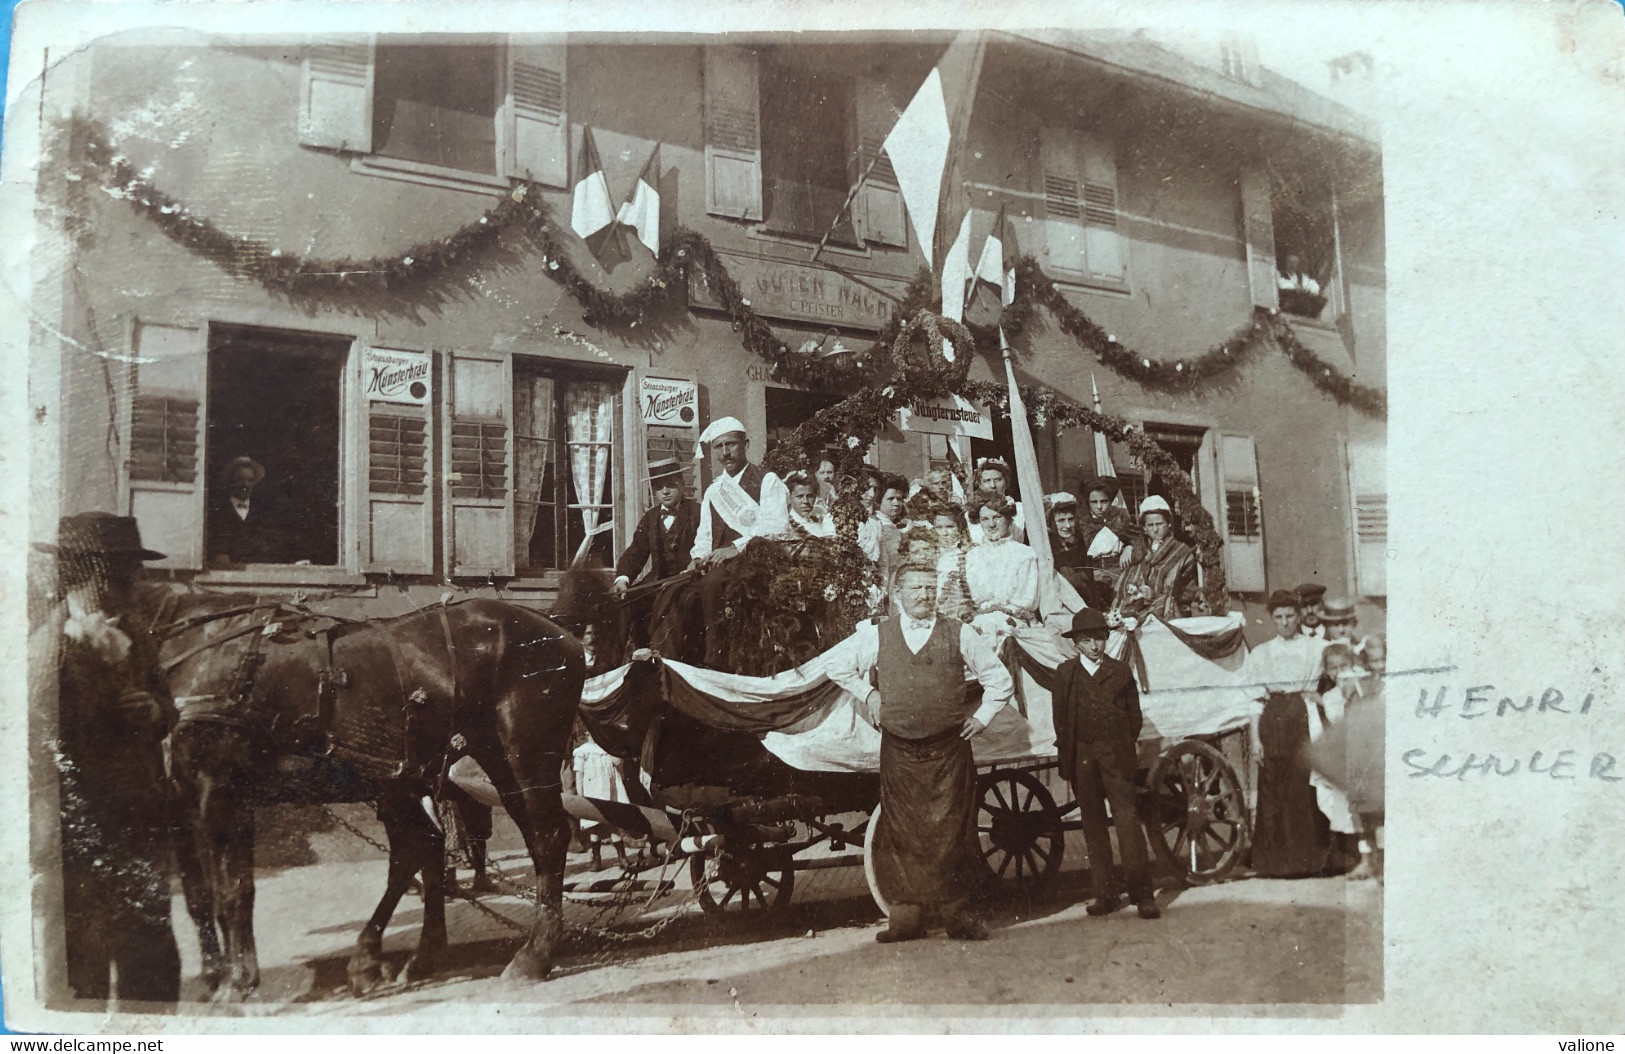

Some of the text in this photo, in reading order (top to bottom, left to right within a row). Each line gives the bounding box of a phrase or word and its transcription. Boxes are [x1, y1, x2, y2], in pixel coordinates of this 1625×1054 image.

[800, 299, 844, 318] PFISTER
[366, 351, 410, 366] Strassburger
[367, 360, 429, 395] Münsterbräu
[643, 381, 679, 393] Strassburger
[644, 388, 695, 419] Münsterbräu
[1402, 748, 1624, 782] SCHULER
